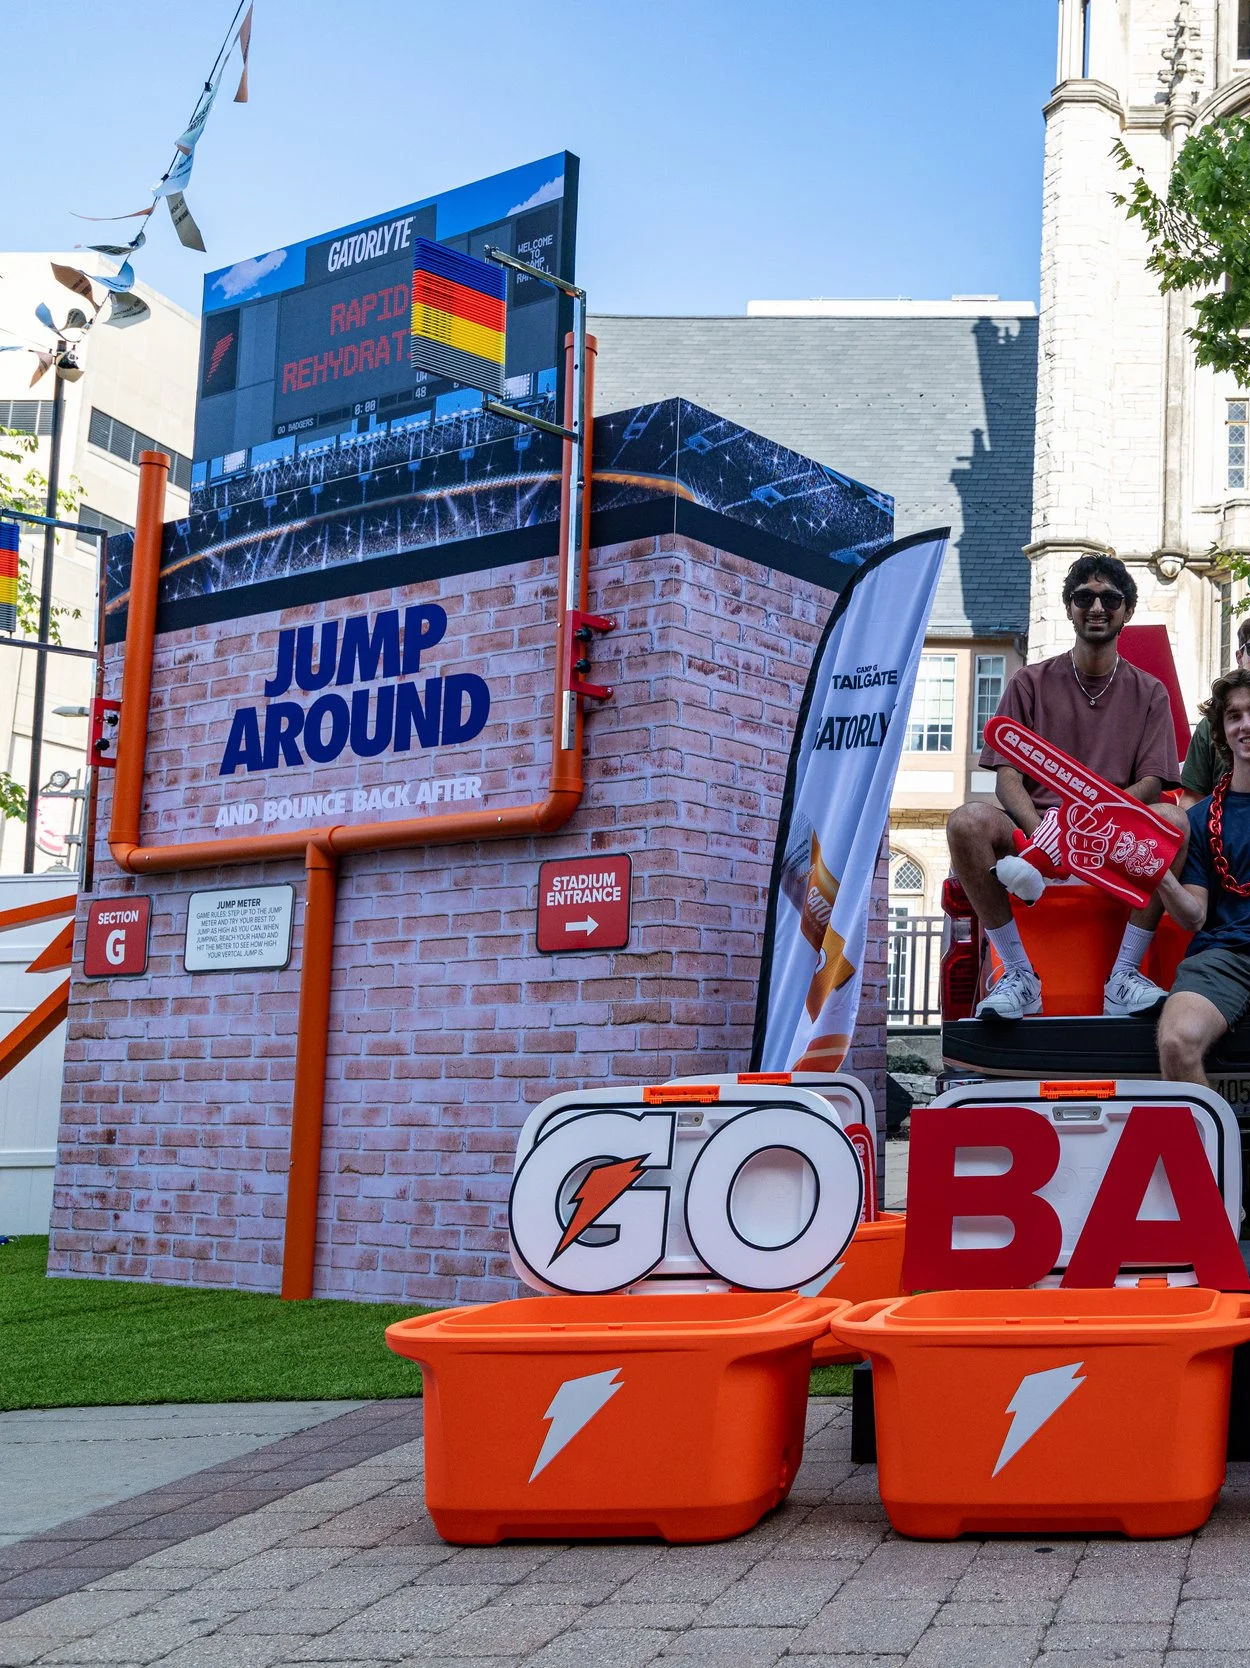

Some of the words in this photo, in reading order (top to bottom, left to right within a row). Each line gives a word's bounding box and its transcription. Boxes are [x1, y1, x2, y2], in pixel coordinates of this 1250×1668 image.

[328, 216, 414, 272] GATORLYTE
[518, 234, 553, 254] WELCOME
[530, 248, 540, 260] TO
[330, 283, 409, 336] RAPID
[282, 328, 413, 394] REHYDRAT
[416, 371, 428, 383] UW
[415, 386, 427, 398] 48
[354, 400, 376, 415] 0:00
[277, 425, 286, 435] GO
[288, 418, 314, 432] BADGERS
[265, 603, 448, 697] JUMP
[856, 665, 872, 674] CAMP
[832, 670, 897, 690] TAILGATE
[219, 672, 491, 776] AROUND
[813, 704, 897, 750] ATORLY
[1004, 730, 1098, 801] BADGERS
[214, 804, 258, 829] AND
[262, 793, 348, 822] BOUNCE
[352, 783, 410, 813] BACK
[415, 776, 483, 805] AFTER
[552, 872, 615, 891] STADIUM
[217, 900, 236, 910] JUMP
[237, 899, 260, 907] METER
[546, 887, 621, 906] ENTRANCE
[98, 910, 139, 925] SECTION
[106, 929, 126, 965] G
[509, 1105, 865, 1294] GO
